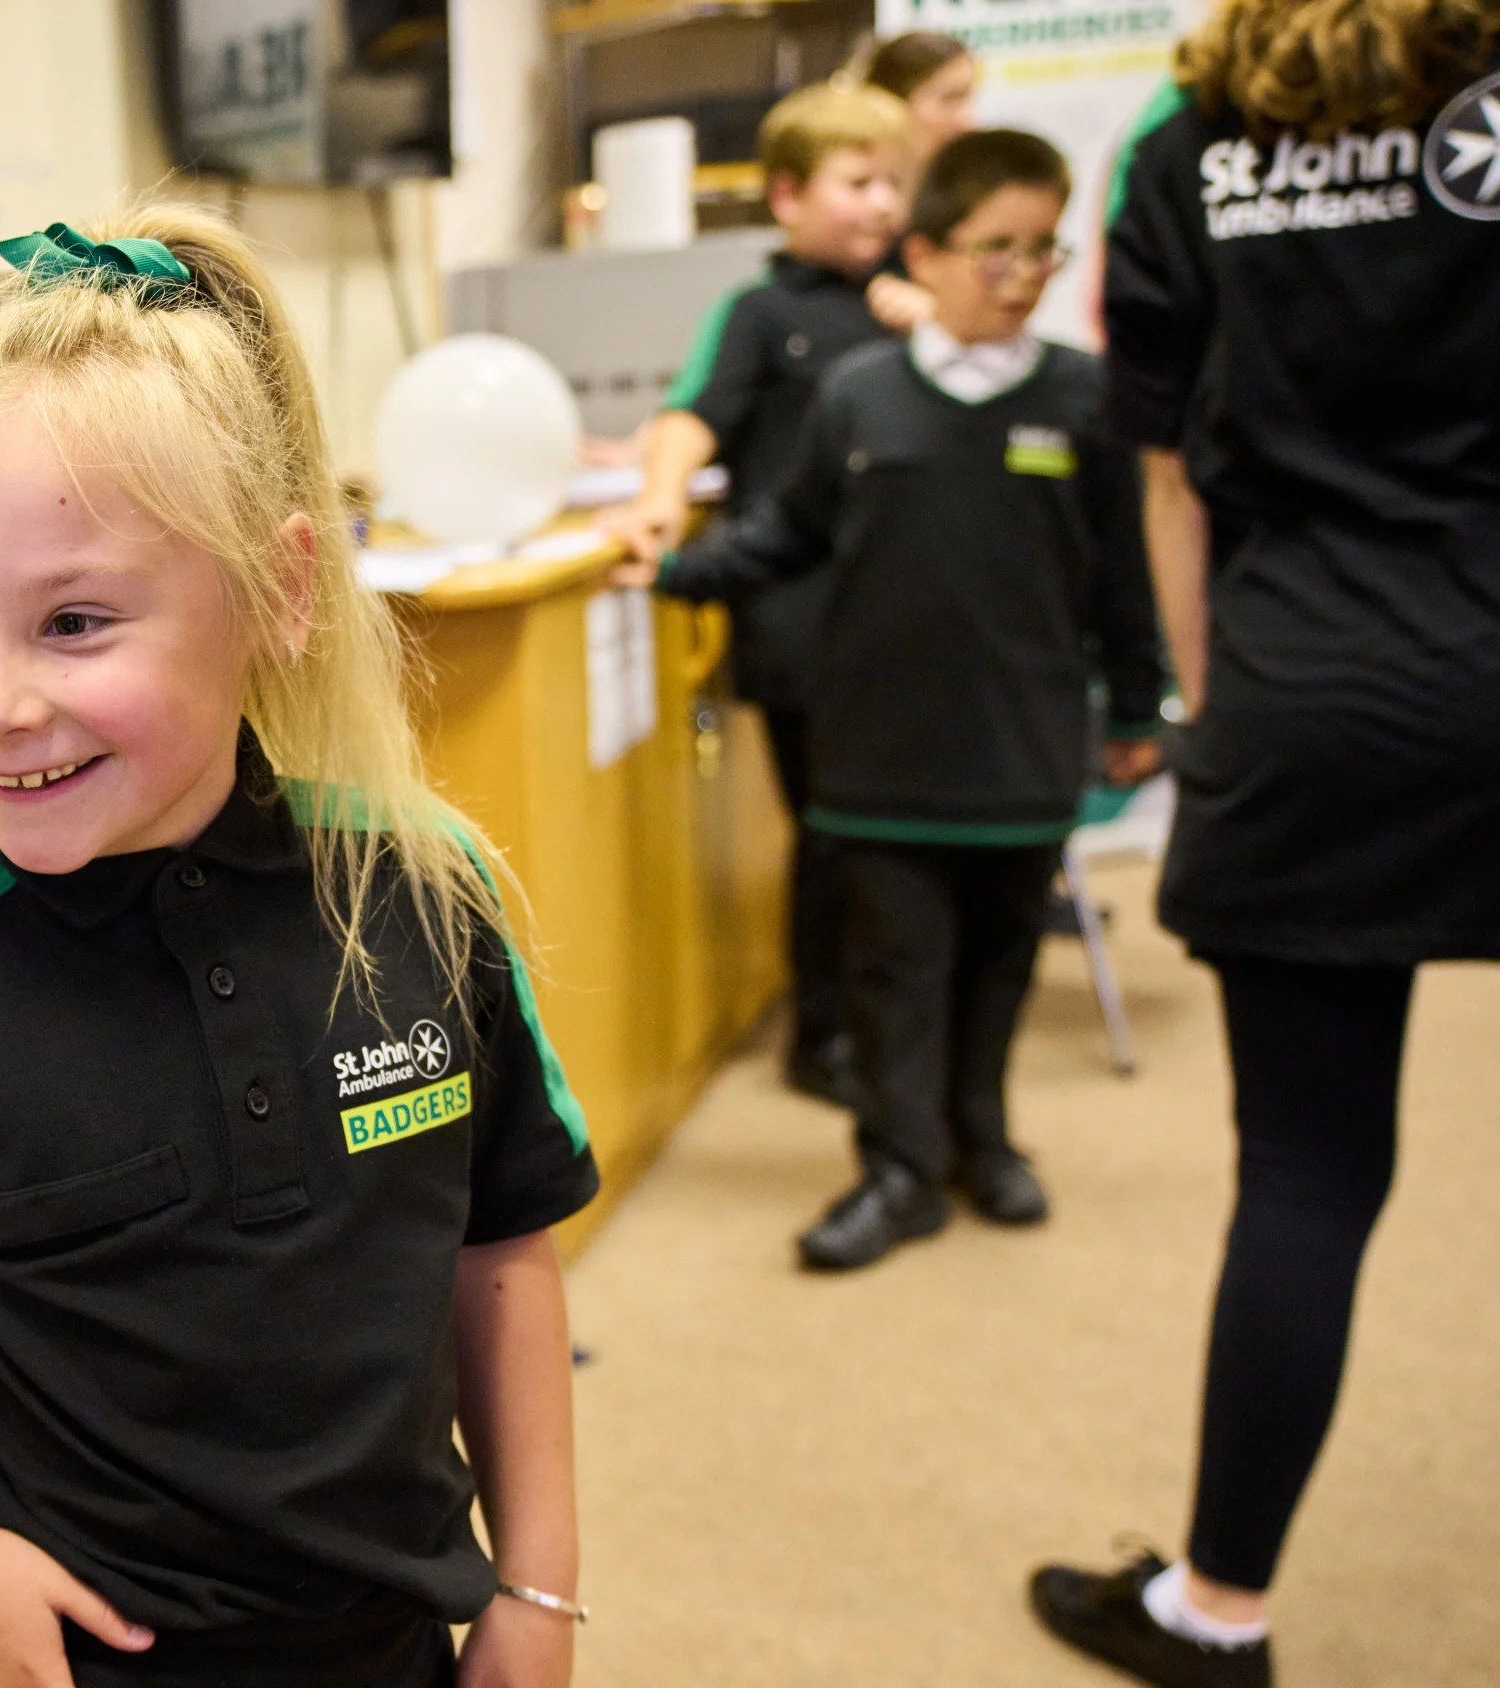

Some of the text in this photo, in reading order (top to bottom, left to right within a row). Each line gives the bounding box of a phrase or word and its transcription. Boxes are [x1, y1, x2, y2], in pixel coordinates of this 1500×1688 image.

[1200, 138, 1262, 205] St
[333, 1041, 410, 1079] St John
[338, 1064, 414, 1098] Ambulance
[348, 1081, 468, 1146] BADGERS
